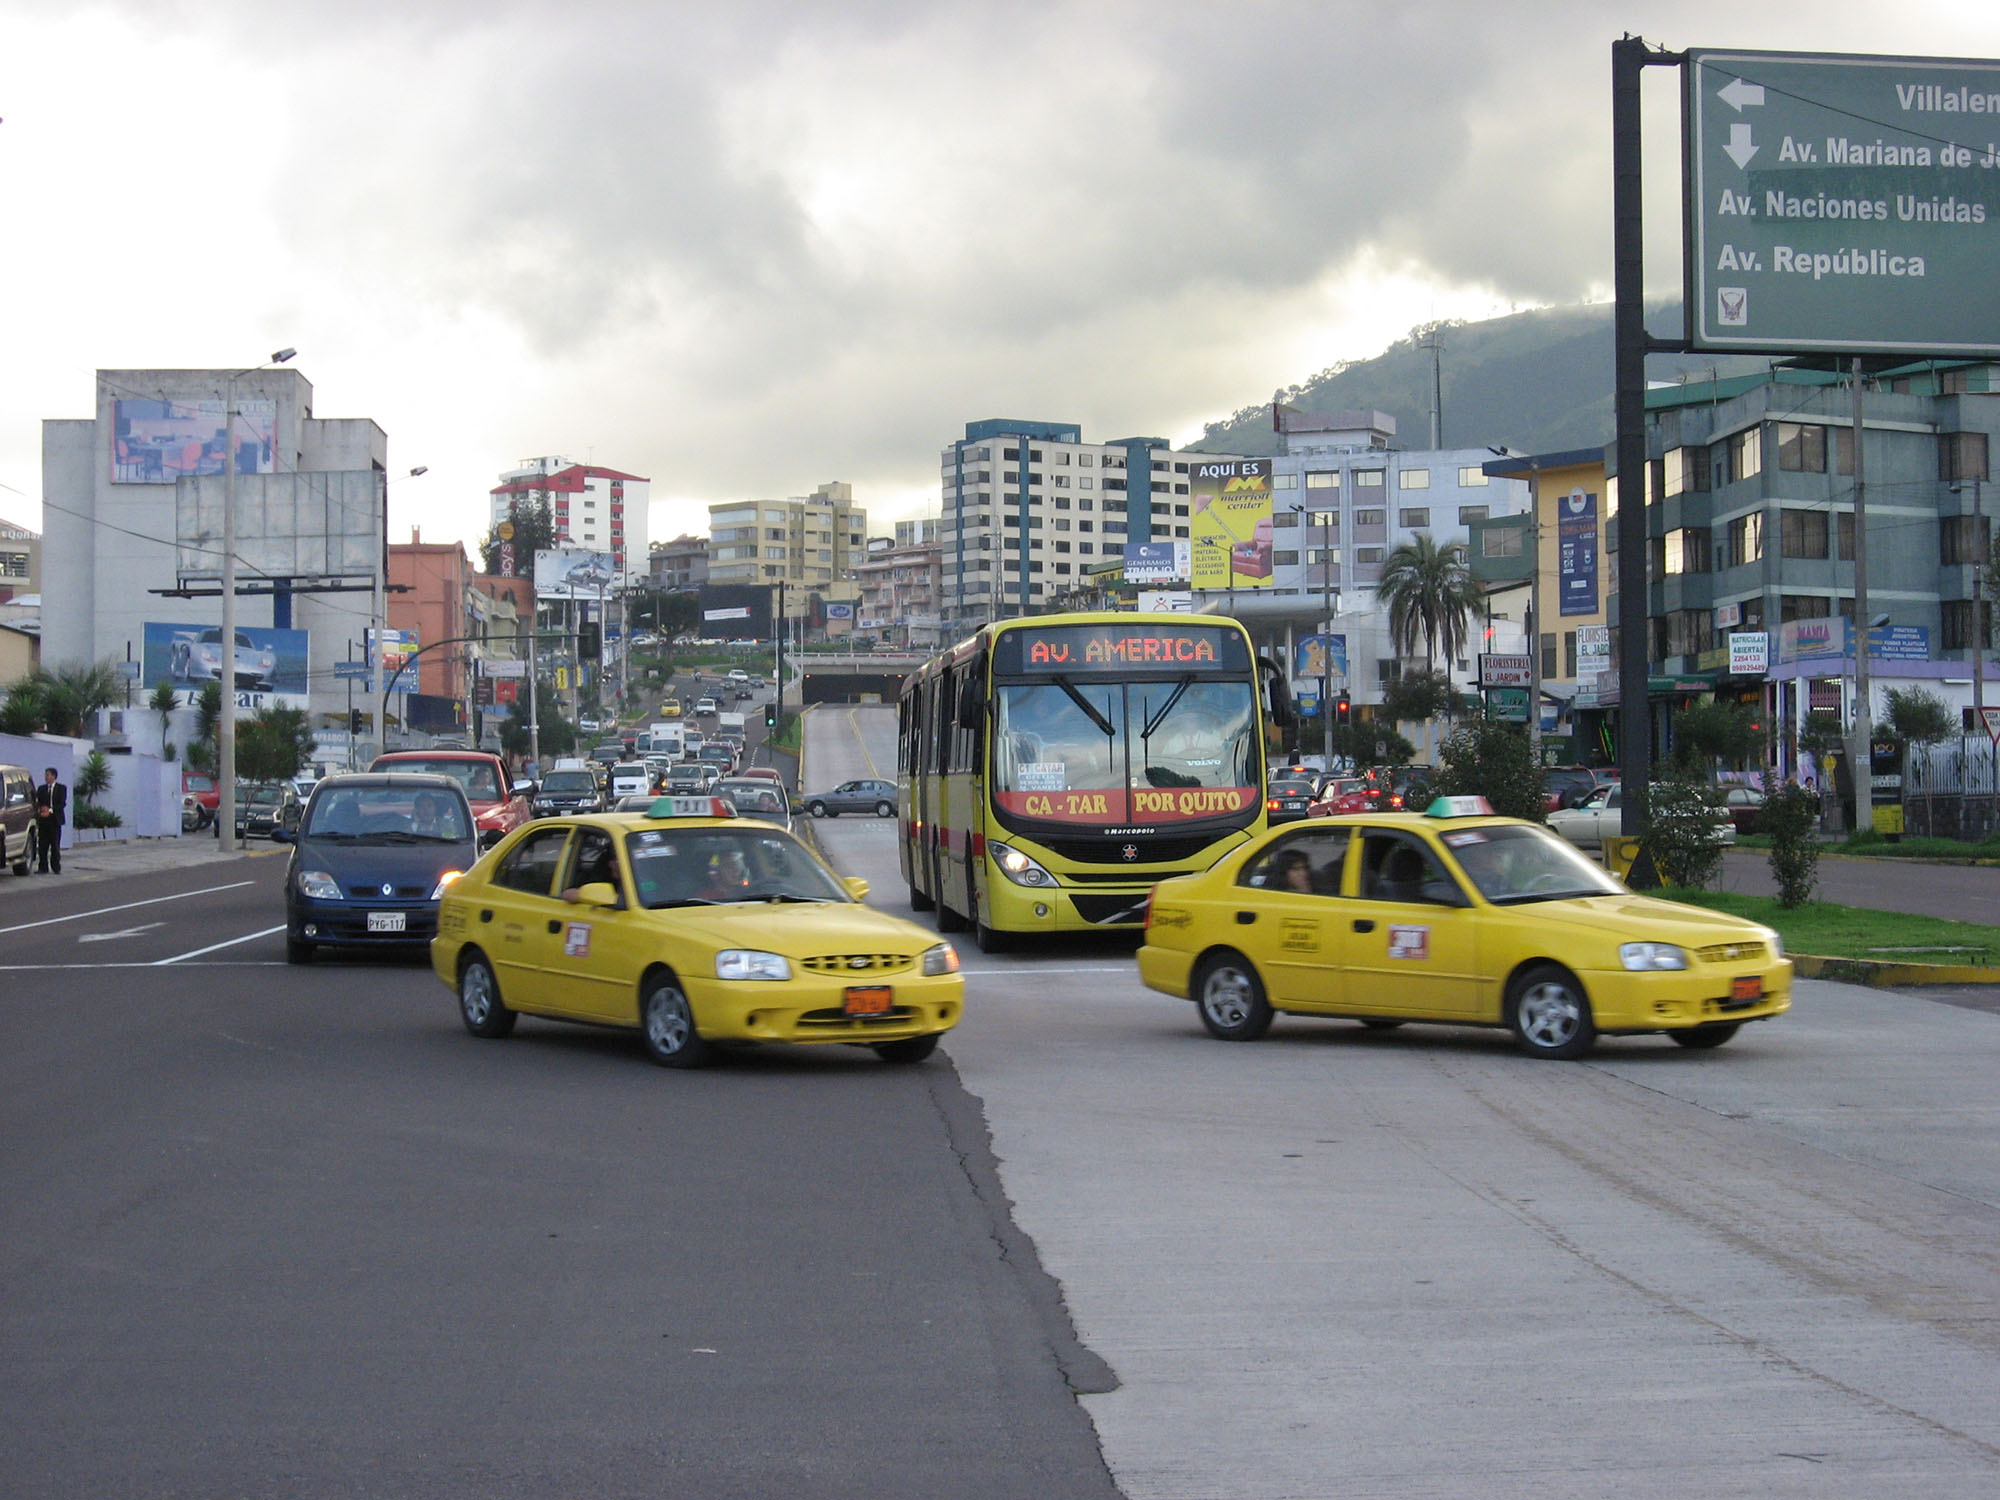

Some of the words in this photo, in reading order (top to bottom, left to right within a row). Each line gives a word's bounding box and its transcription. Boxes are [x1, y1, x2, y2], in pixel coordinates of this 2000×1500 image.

[1778, 136, 1817, 163] Av.
[1826, 137, 1931, 167] Mariana
[1940, 141, 1972, 168] de
[1718, 189, 1756, 216] Av.
[1766, 190, 1888, 220] Naciones
[1896, 195, 1986, 223] Unidas
[1717, 244, 1762, 272] Av.
[1773, 246, 1925, 280] República
[1200, 462, 1235, 478] AQUÍ
[1242, 463, 1259, 475] ES
[1227, 502, 1264, 511] center
[1085, 637, 1215, 663] AMERICA
[1186, 759, 1222, 767] VOLVO
[1025, 795, 1054, 816] CA
[1066, 794, 1108, 815] TAR
[1134, 791, 1177, 813] POR
[1179, 790, 1242, 816] QUITO
